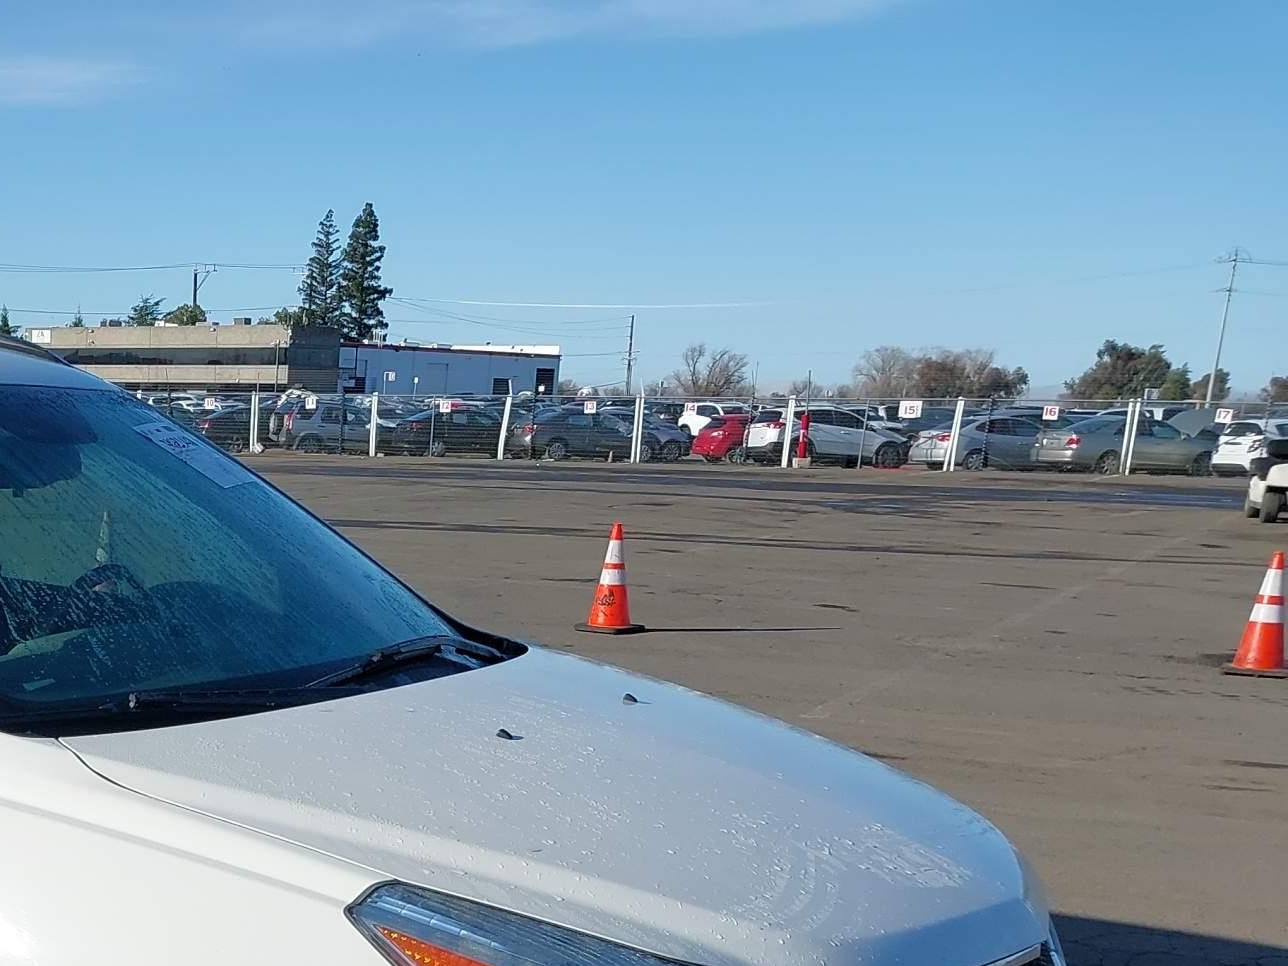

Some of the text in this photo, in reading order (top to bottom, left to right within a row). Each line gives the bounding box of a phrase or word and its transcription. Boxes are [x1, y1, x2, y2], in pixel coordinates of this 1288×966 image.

[585, 401, 595, 411] 13
[1044, 407, 1057, 417] 16
[1217, 410, 1231, 420] 17
